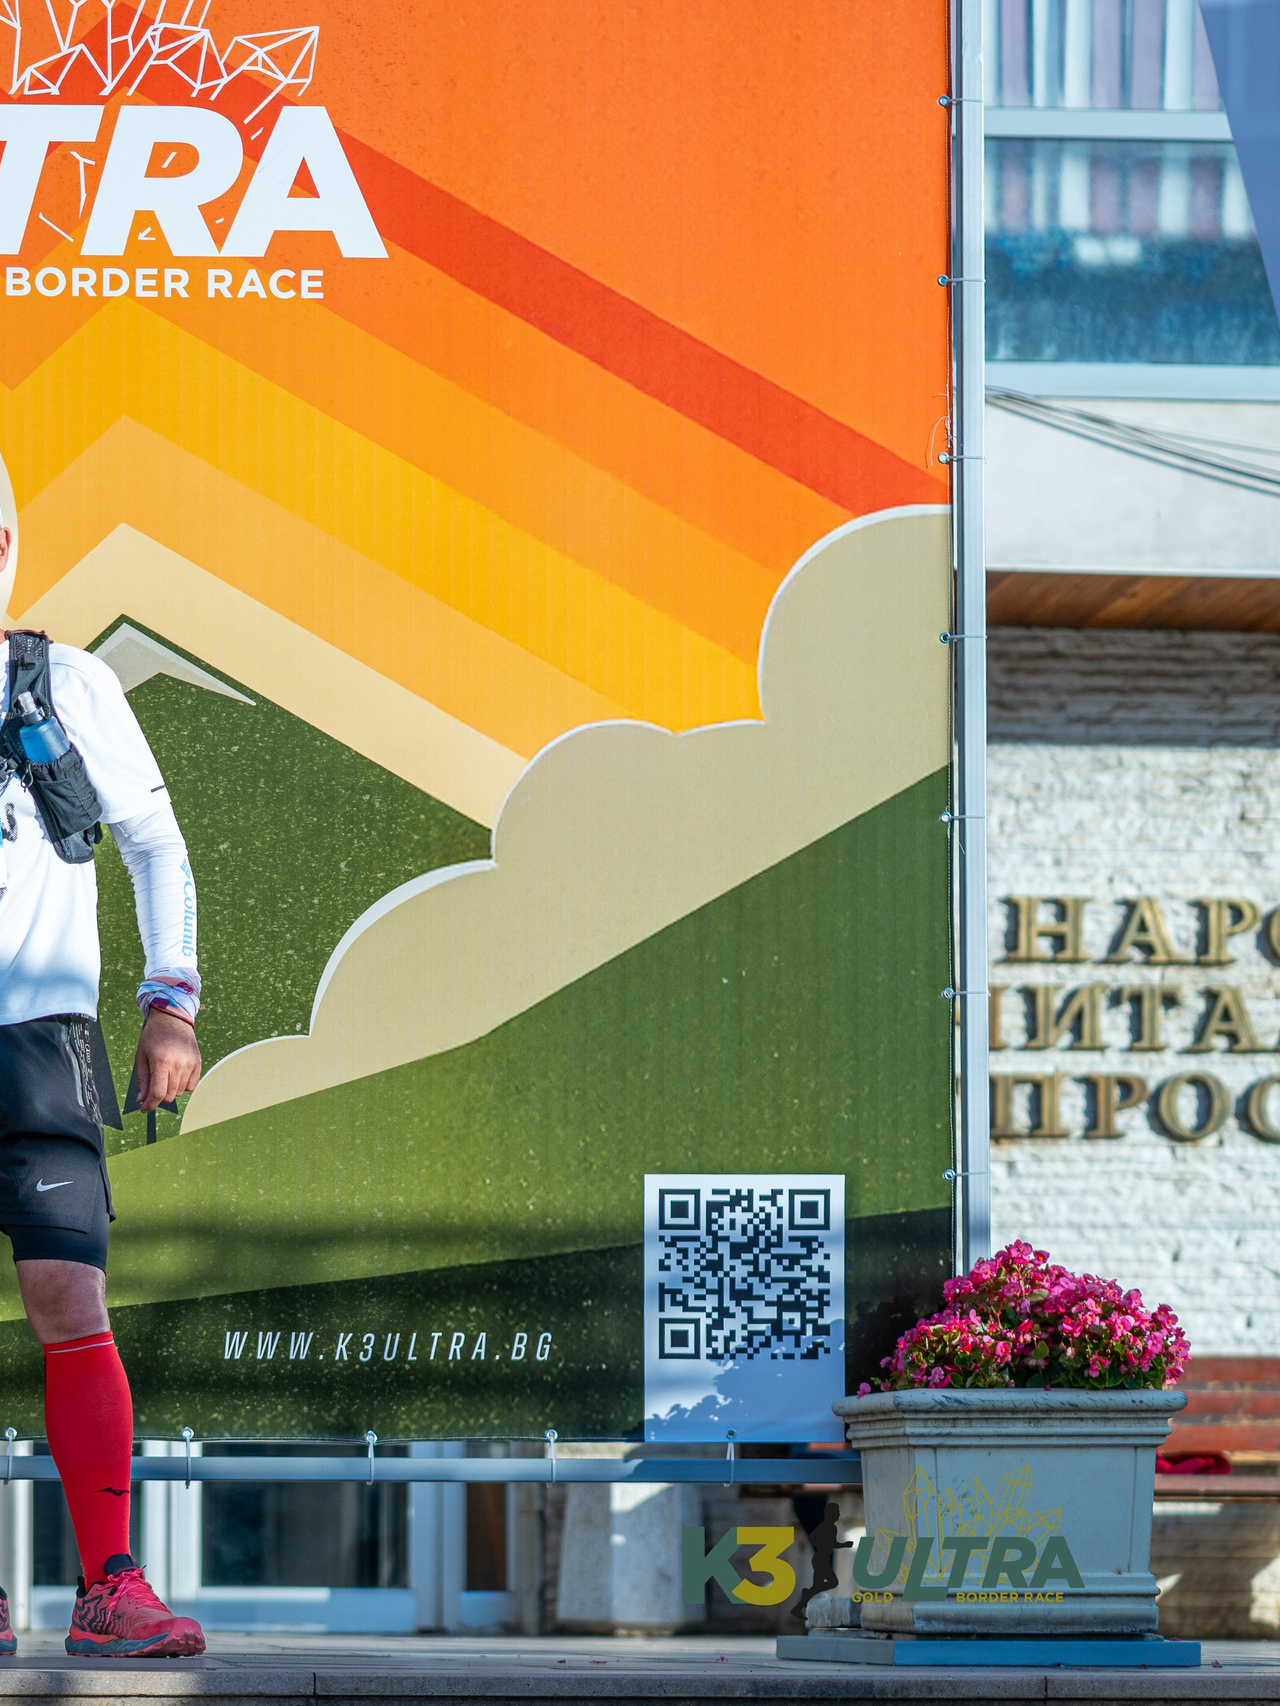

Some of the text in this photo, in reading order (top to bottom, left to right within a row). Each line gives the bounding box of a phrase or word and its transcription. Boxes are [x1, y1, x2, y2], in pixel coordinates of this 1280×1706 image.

[5, 267, 193, 300] BORDER
[206, 267, 325, 300] RACE
[1005, 896, 1280, 965] НАР
[990, 984, 1280, 1053] ИТА
[223, 1331, 554, 1362] WWW.K3ULTRA.BG
